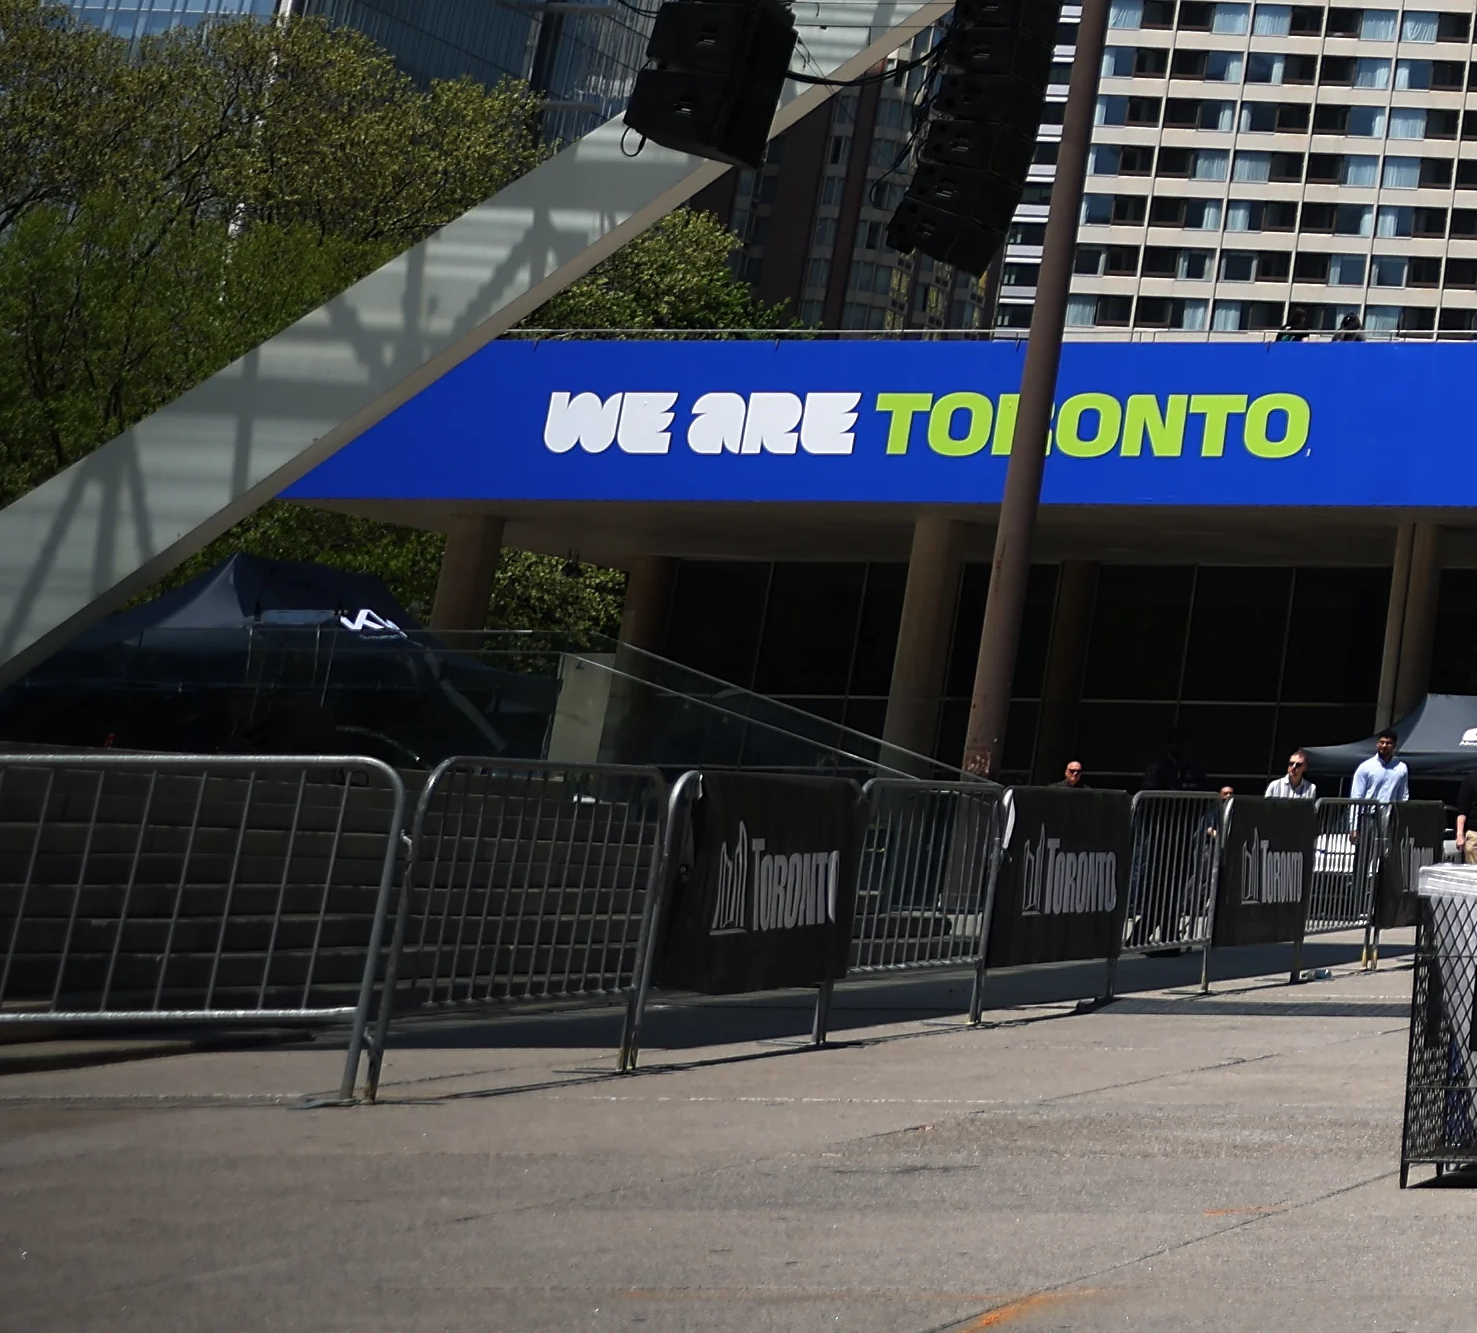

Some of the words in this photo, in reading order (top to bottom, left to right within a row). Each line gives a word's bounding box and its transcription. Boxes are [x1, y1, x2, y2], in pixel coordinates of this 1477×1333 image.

[543, 391, 679, 454] WE
[875, 391, 1311, 458] TOONTO
[1045, 838, 1117, 915] TORONTO
[1260, 839, 1304, 904] TORONTO
